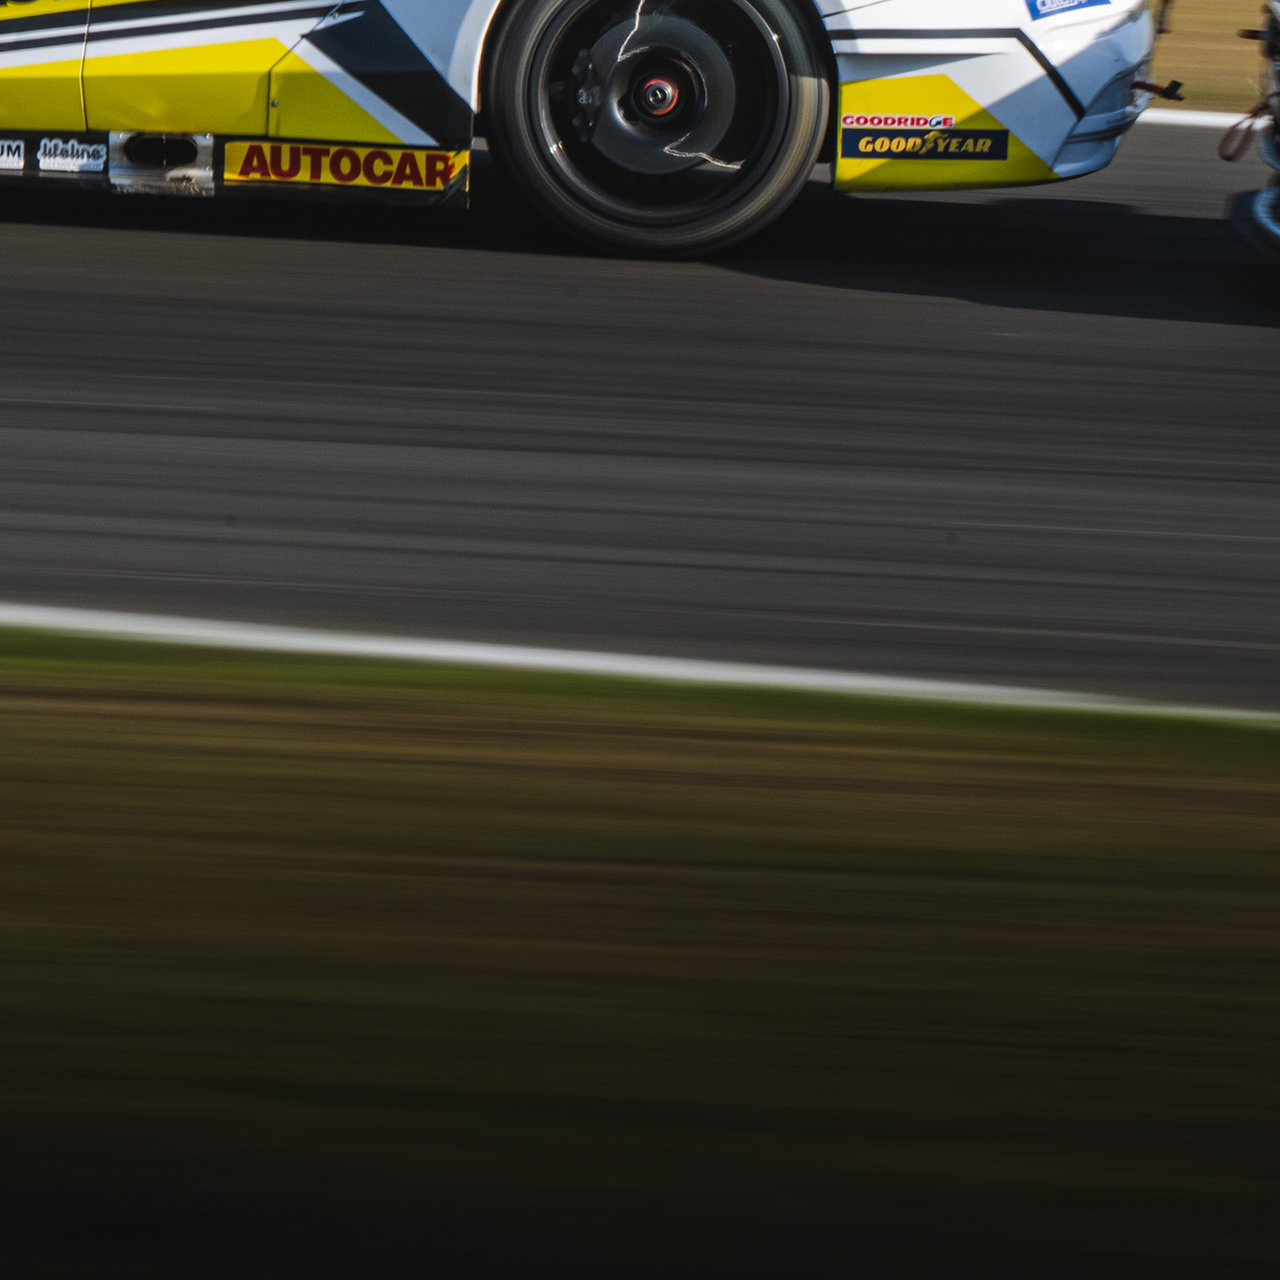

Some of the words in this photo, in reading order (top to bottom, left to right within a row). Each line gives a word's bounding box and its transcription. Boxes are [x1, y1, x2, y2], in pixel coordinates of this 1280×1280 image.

[841, 114, 954, 128] GOODRIDGE
[858, 130, 993, 155] GOODYEAR
[237, 143, 456, 188] AUTOCAR
